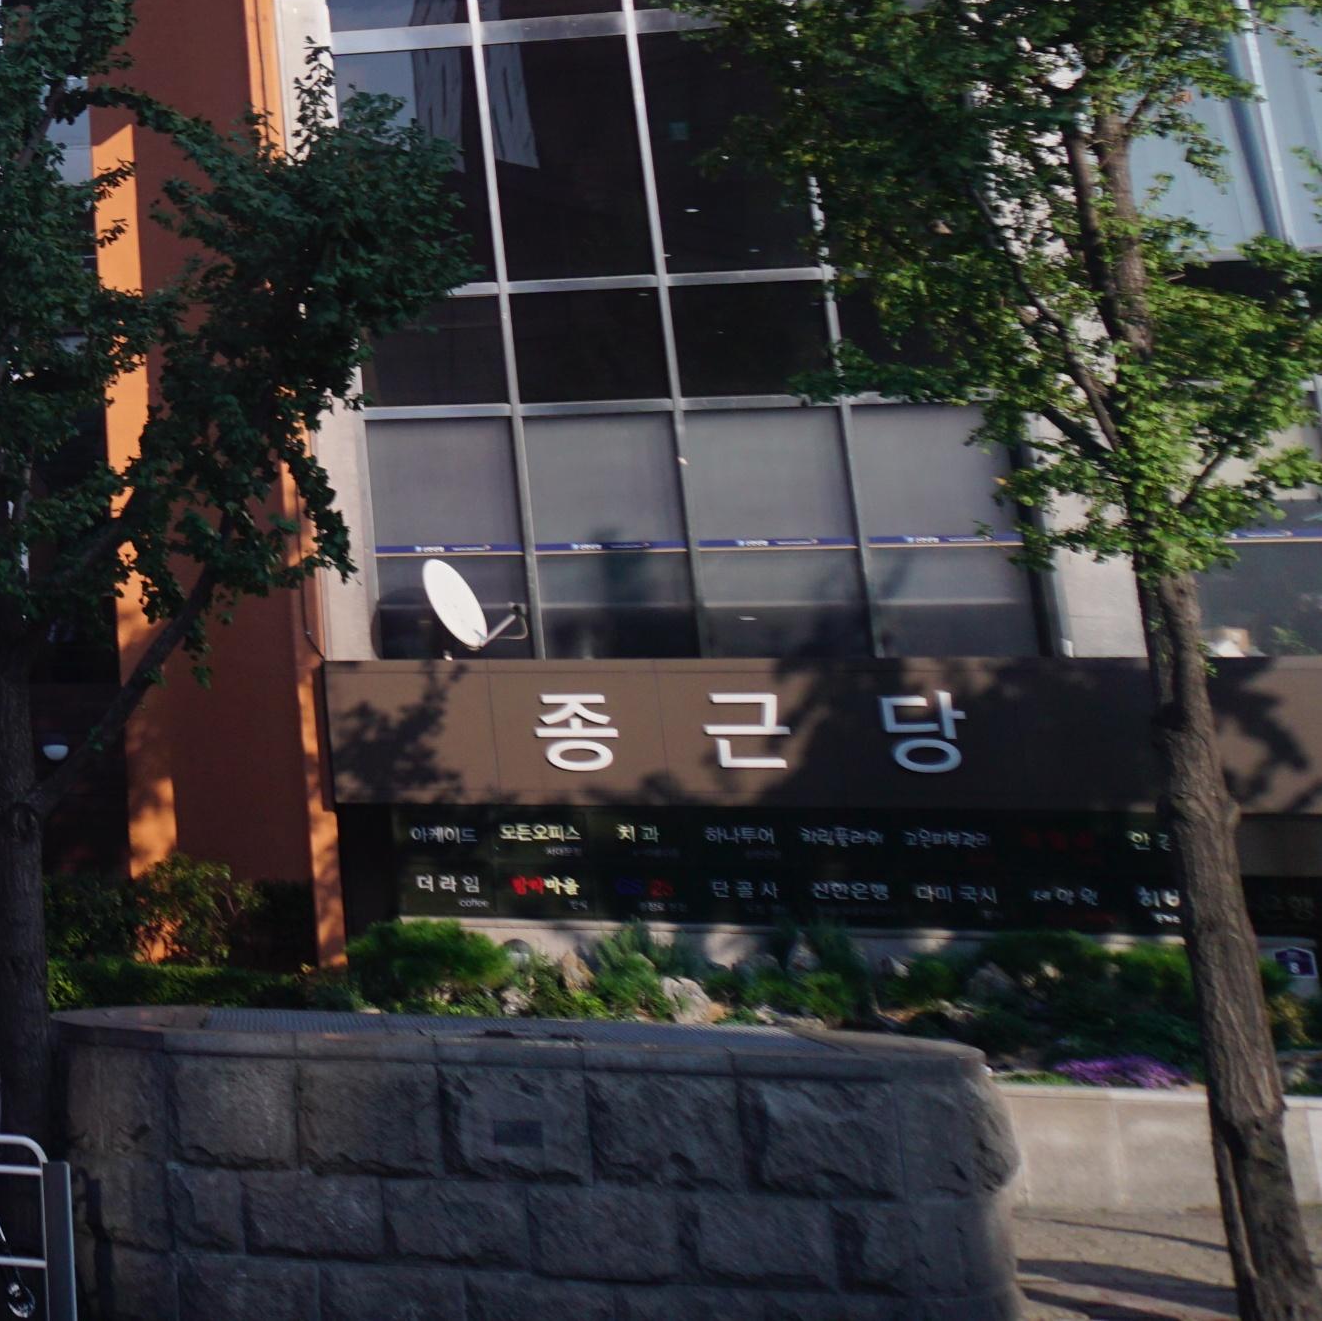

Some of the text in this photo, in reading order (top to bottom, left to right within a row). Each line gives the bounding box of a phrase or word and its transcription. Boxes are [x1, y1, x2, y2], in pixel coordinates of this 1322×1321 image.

[534, 689, 966, 775] 종근당
[410, 826, 478, 844] 아케이드
[499, 823, 582, 842] 모든오피스
[704, 825, 776, 845] 하나투어
[415, 874, 480, 894] 더라임
[811, 880, 890, 901] 신한은행
